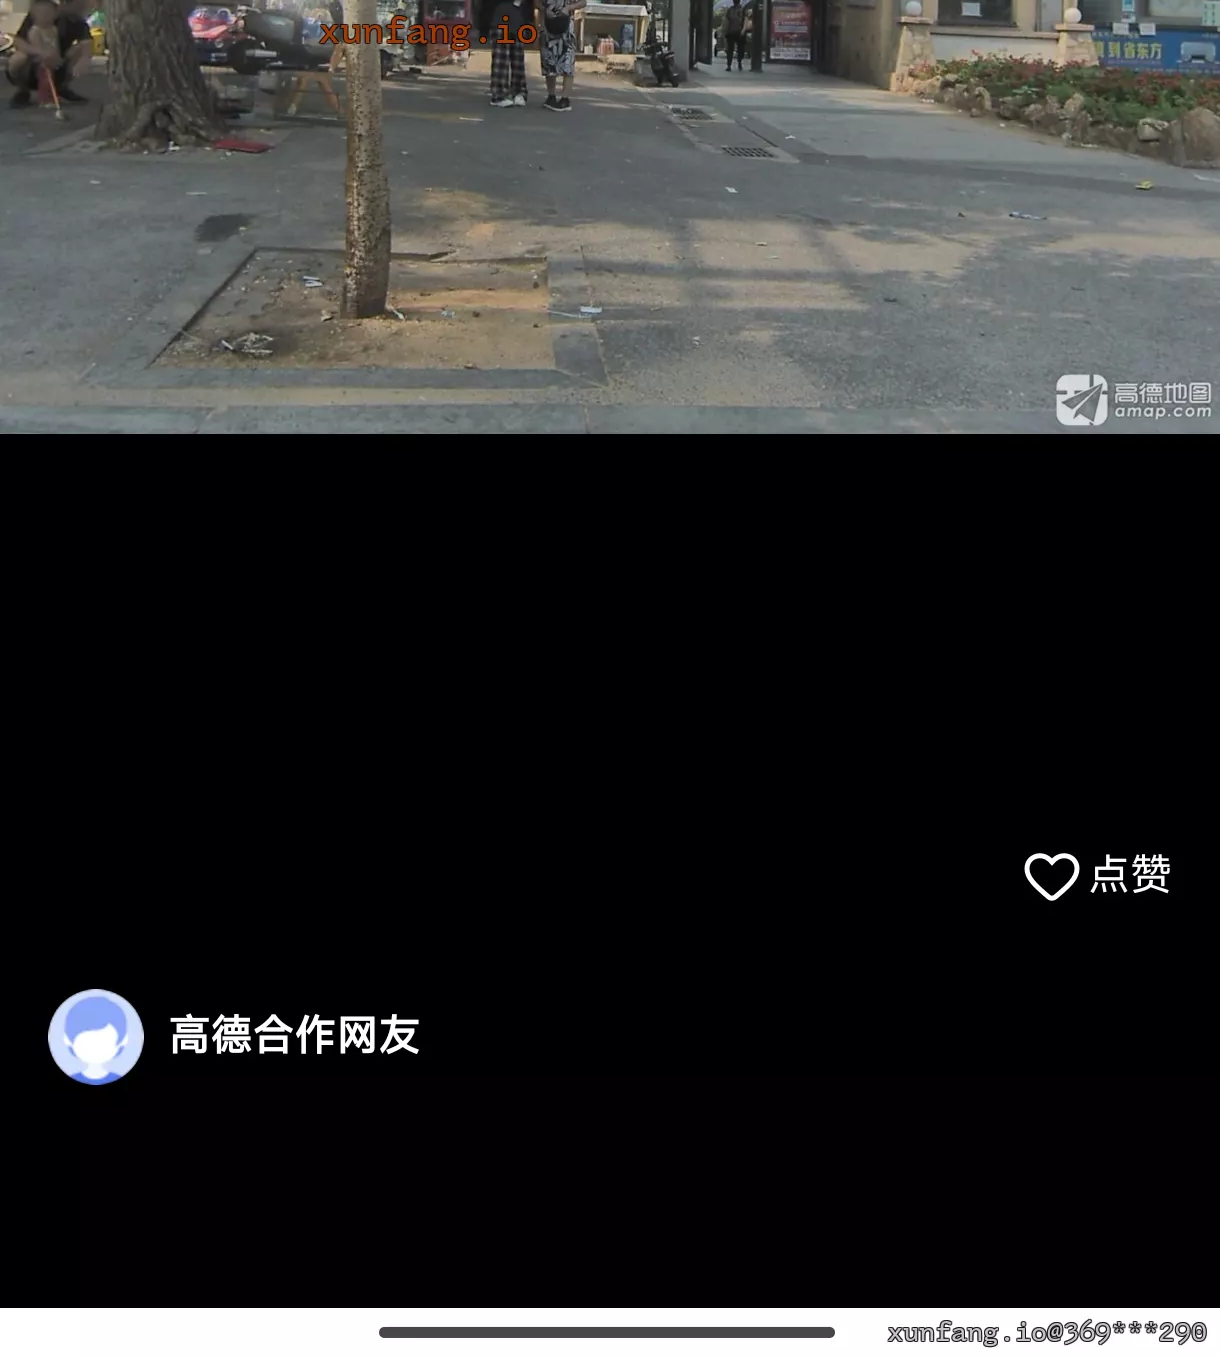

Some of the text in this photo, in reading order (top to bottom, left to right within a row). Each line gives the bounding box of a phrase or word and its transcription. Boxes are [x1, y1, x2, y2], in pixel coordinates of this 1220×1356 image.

[1089, 853, 1171, 894] 点赞
[169, 1012, 420, 1055] 高德合作网友
